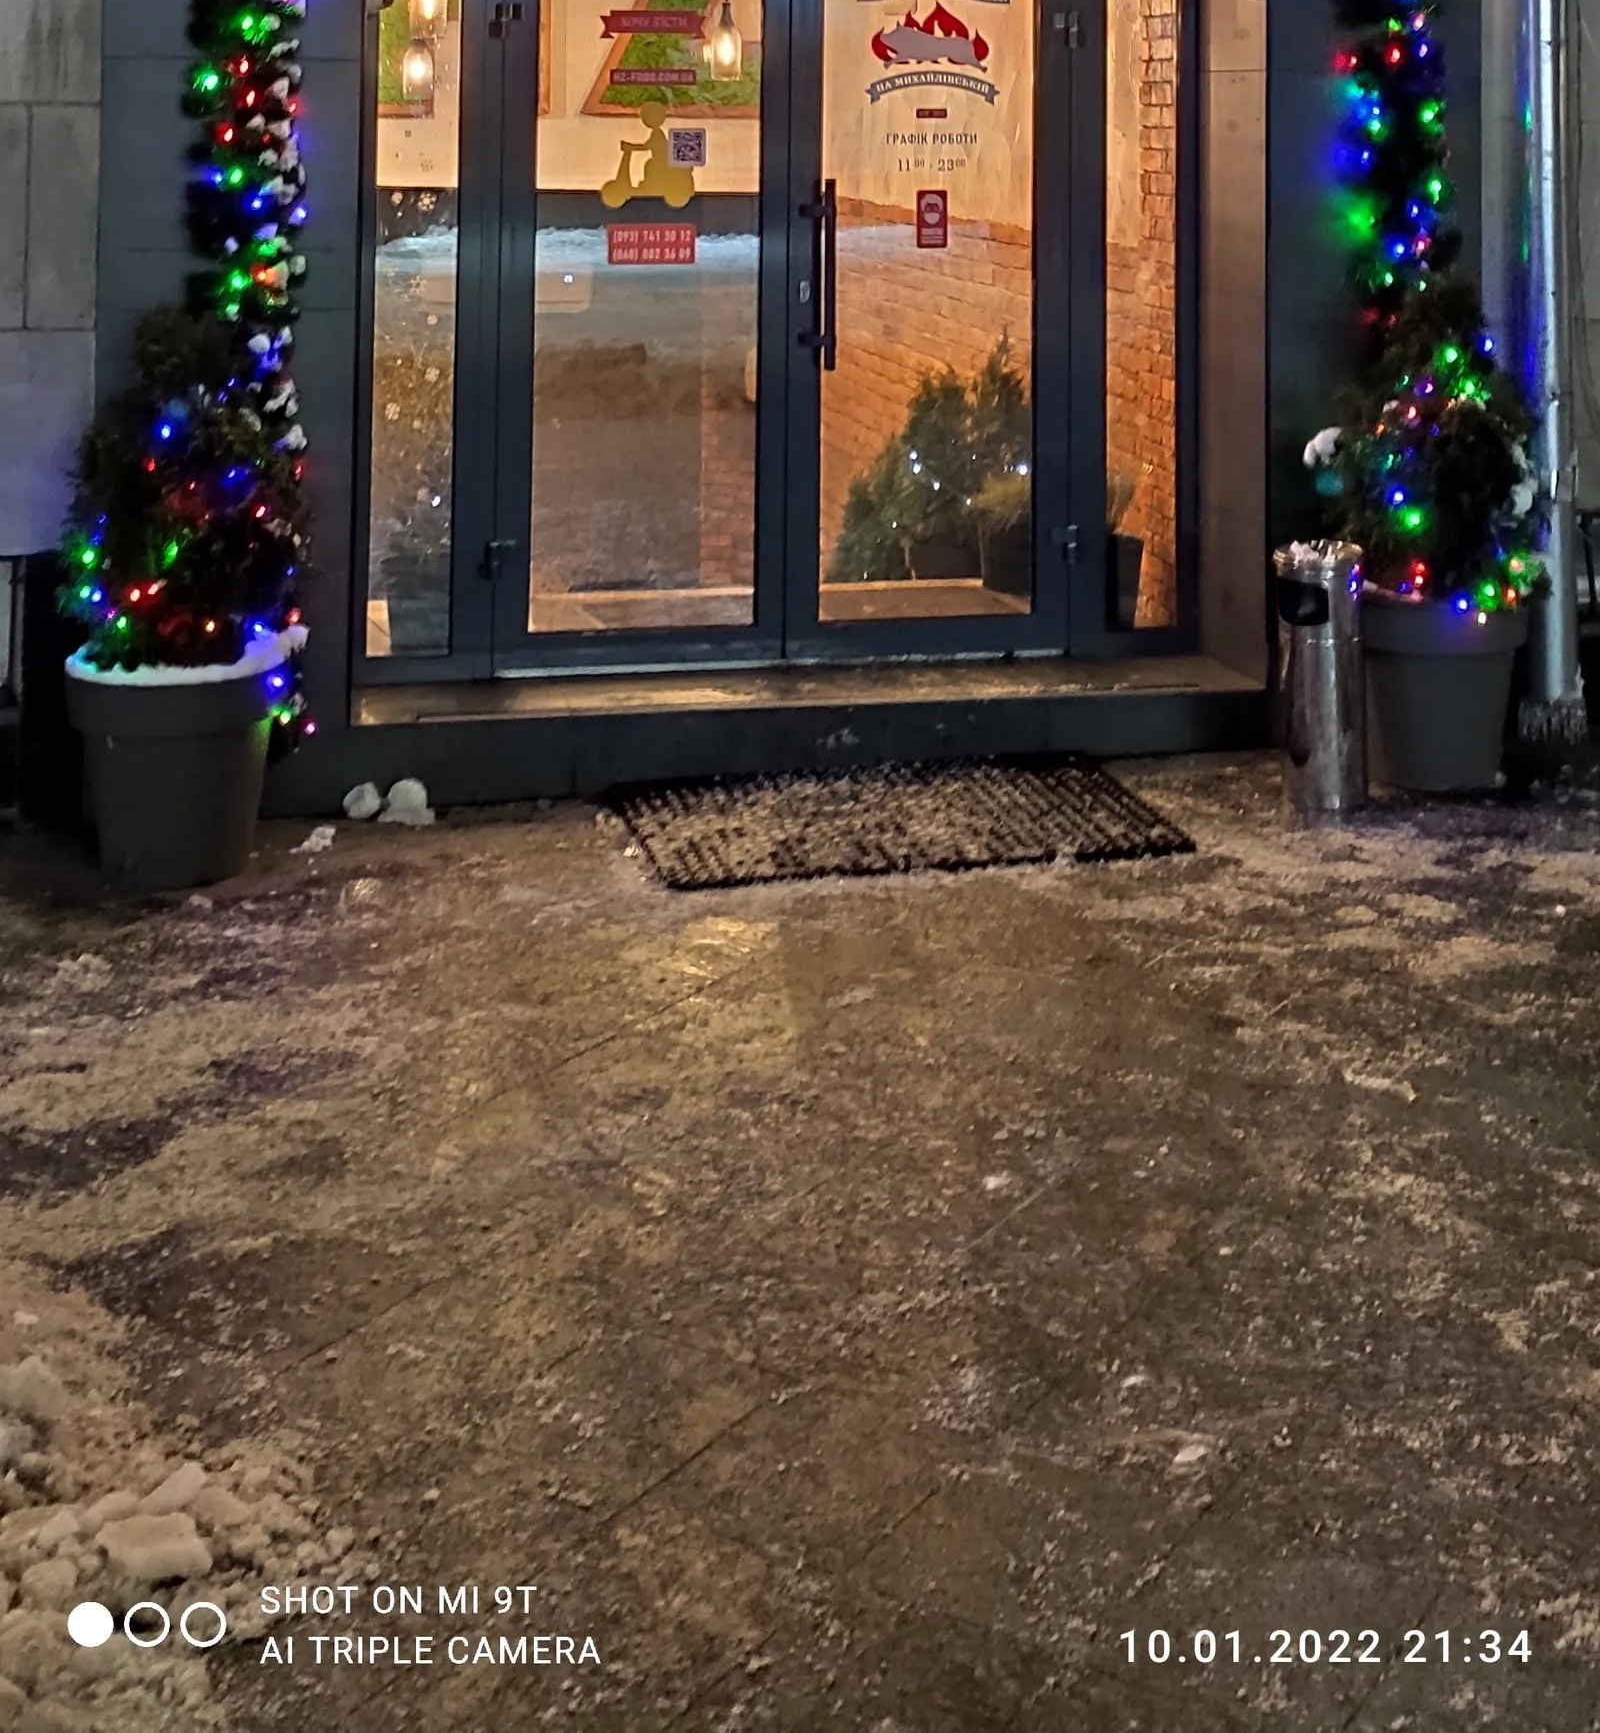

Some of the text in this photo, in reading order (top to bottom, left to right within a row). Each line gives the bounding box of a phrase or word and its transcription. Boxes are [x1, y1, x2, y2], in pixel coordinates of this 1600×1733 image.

[876, 71, 990, 94] НА МИХАЙЛІВСЬКІЙ
[886, 132, 978, 145] ГРАФІК РОБОТИ
